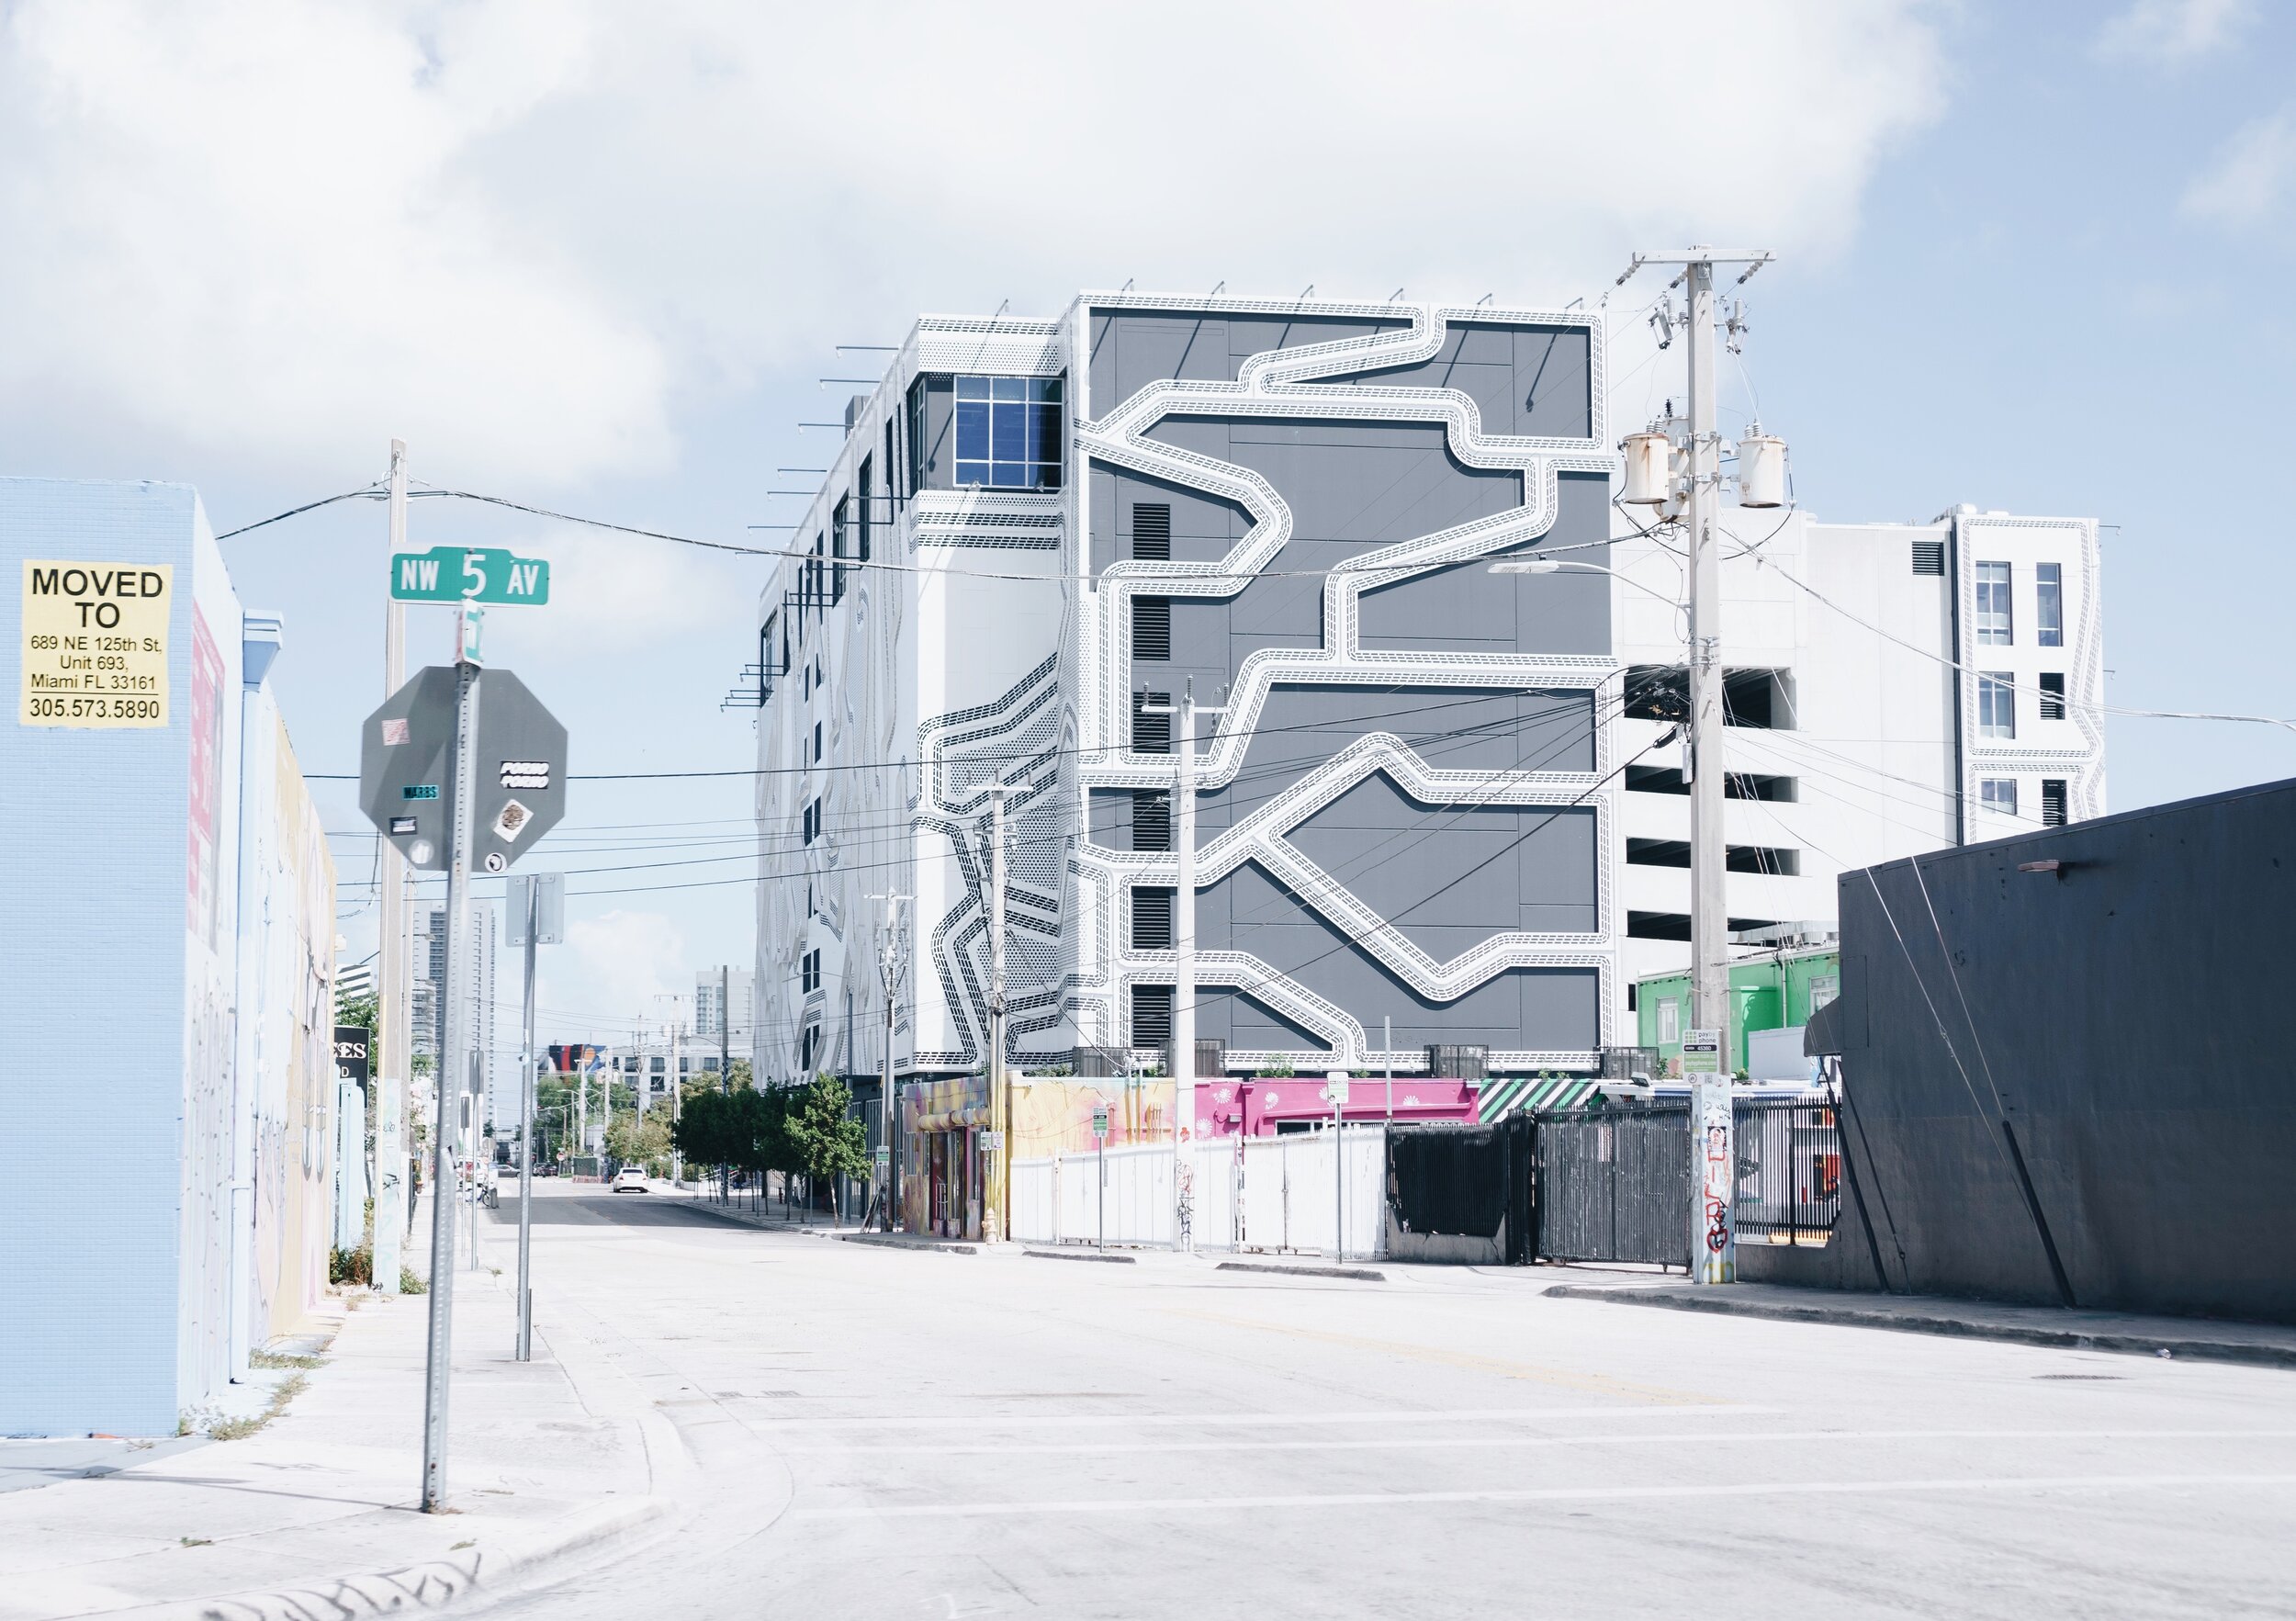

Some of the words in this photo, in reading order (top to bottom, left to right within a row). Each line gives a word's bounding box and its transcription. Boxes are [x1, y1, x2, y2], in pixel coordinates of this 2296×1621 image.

[32, 568, 163, 598] MOVED
[400, 559, 439, 591] NW
[461, 555, 487, 597] 5
[506, 564, 539, 595] AV
[74, 602, 120, 629] TO
[30, 635, 59, 650] 689
[64, 636, 88, 651] NE
[95, 636, 137, 652] 125th
[60, 655, 92, 670] Unit
[96, 656, 129, 672] 693,
[30, 673, 78, 689] Miami
[84, 674, 106, 690] FL
[110, 675, 155, 690] 33161
[29, 698, 160, 719] 305.573.5890
